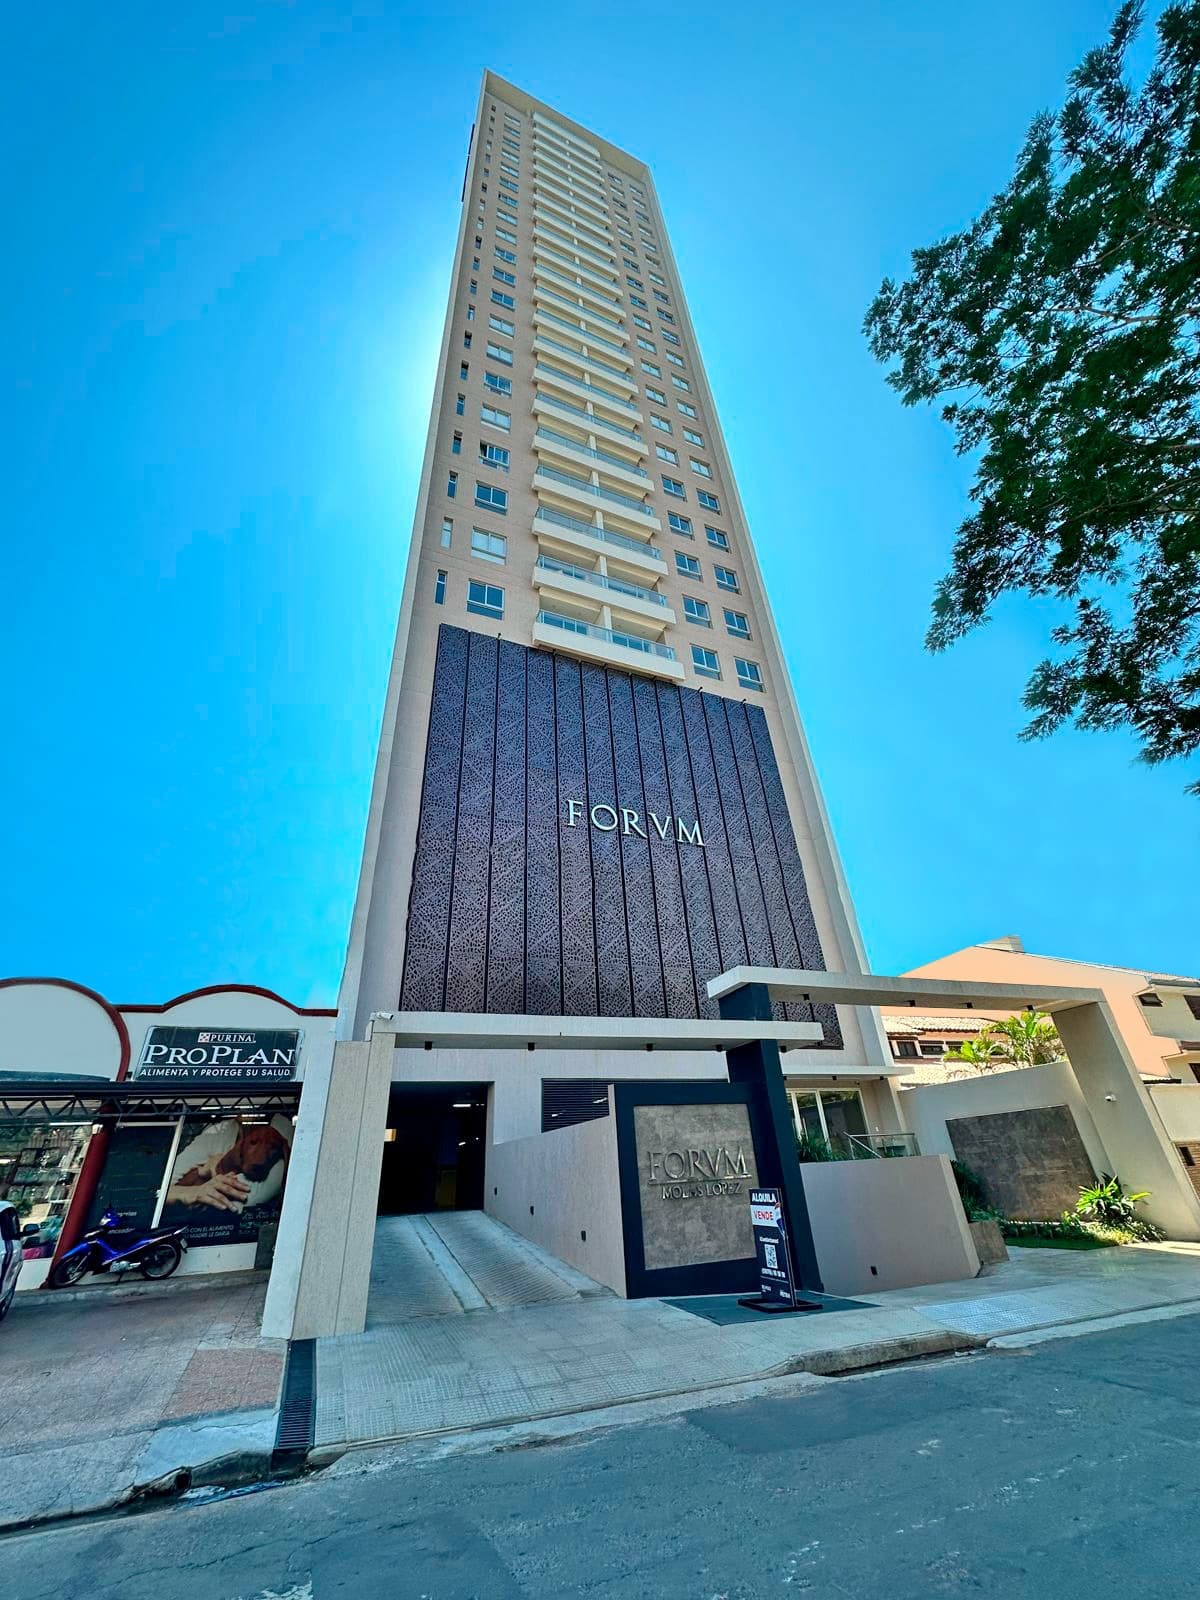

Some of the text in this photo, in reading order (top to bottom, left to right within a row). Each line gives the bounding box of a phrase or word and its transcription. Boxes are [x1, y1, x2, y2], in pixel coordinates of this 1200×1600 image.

[567, 799, 705, 847] FORVM
[210, 1034, 252, 1043] PURINA
[140, 1068, 291, 1077] ALIMENTA Y PROTEGE SU SALUD
[647, 1146, 749, 1181] FORVM
[705, 1181, 743, 1196] LOPEZ
[751, 1192, 777, 1203] ALQUILA
[753, 1210, 774, 1221] VENDE
